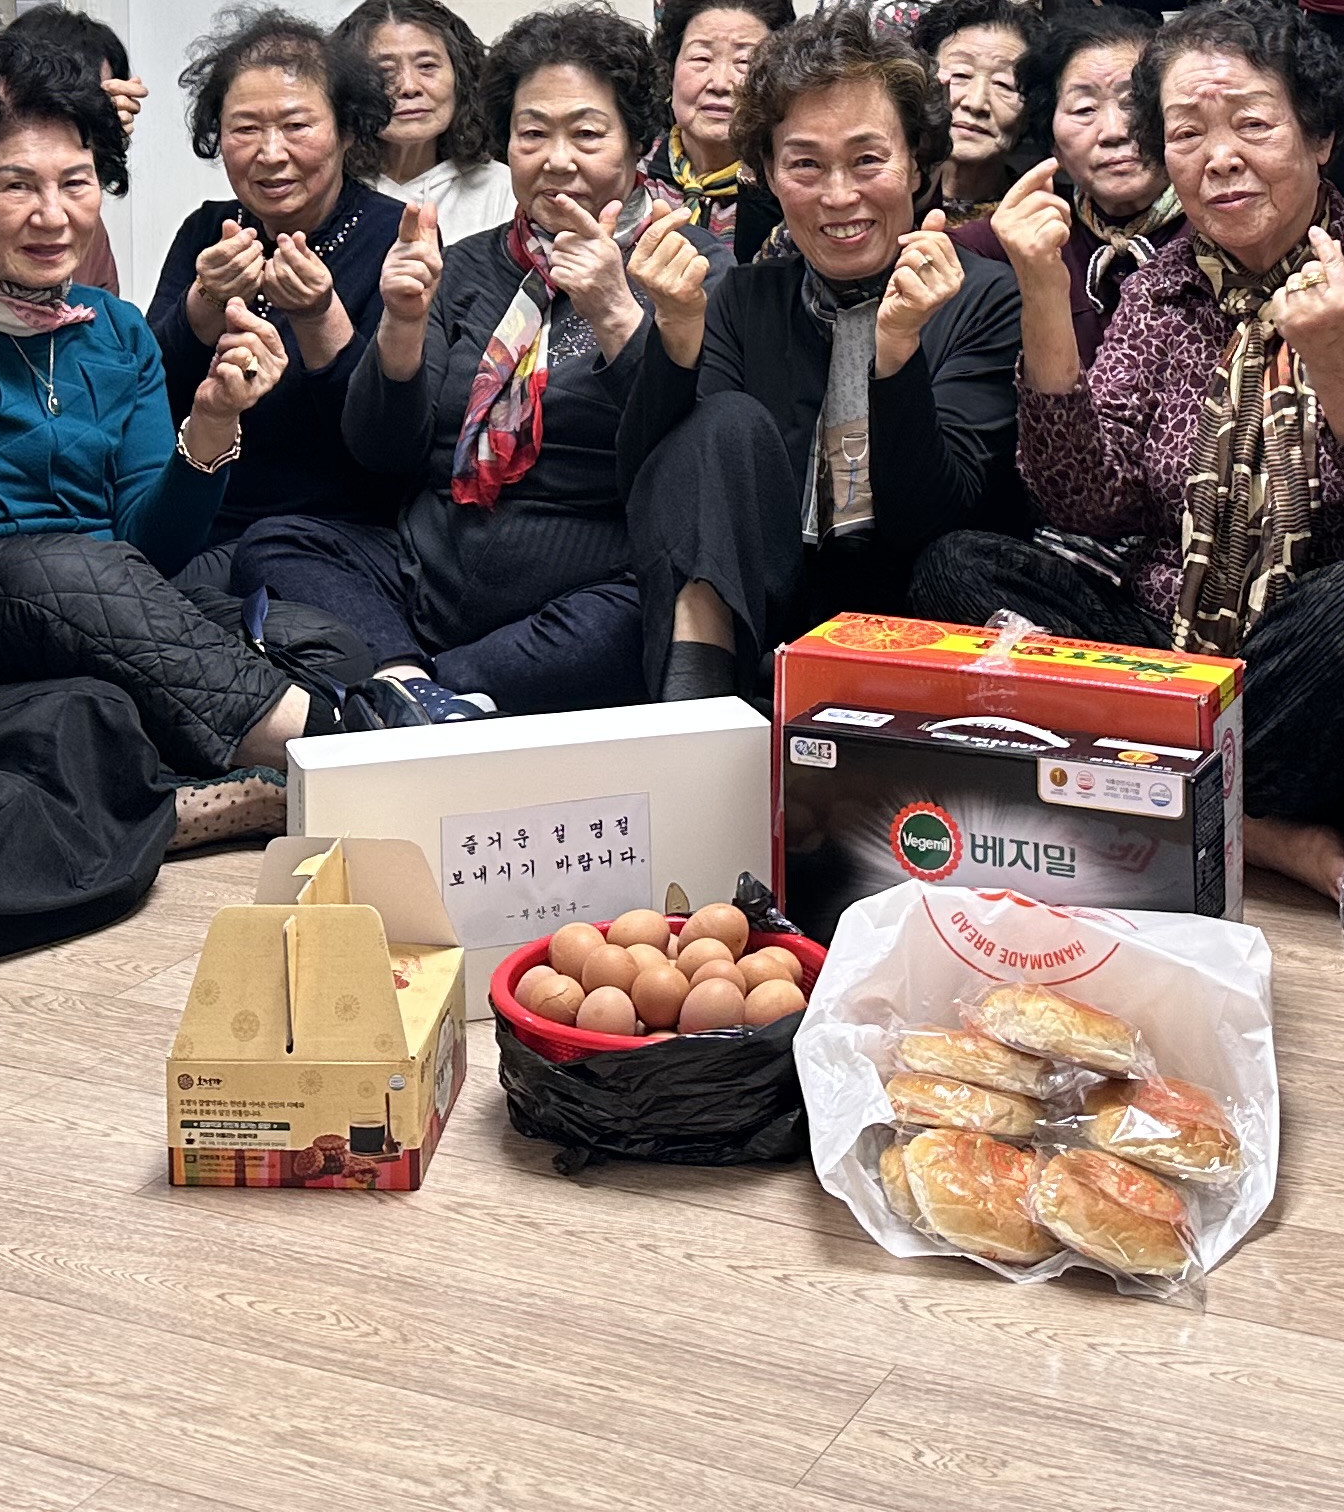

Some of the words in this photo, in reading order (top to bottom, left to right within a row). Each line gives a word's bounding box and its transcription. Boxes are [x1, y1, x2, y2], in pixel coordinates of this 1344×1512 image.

[461, 828, 530, 856] 즐거운
[551, 823, 565, 844] 설
[589, 815, 629, 839] 명절
[902, 831, 950, 852] Vegemil
[968, 832, 1076, 879] 베지밀
[448, 859, 536, 887] 보내시기
[556, 846, 646, 874] 바랍니다.
[950, 911, 996, 957] BREAD
[998, 939, 1086, 970] HANDMADE
